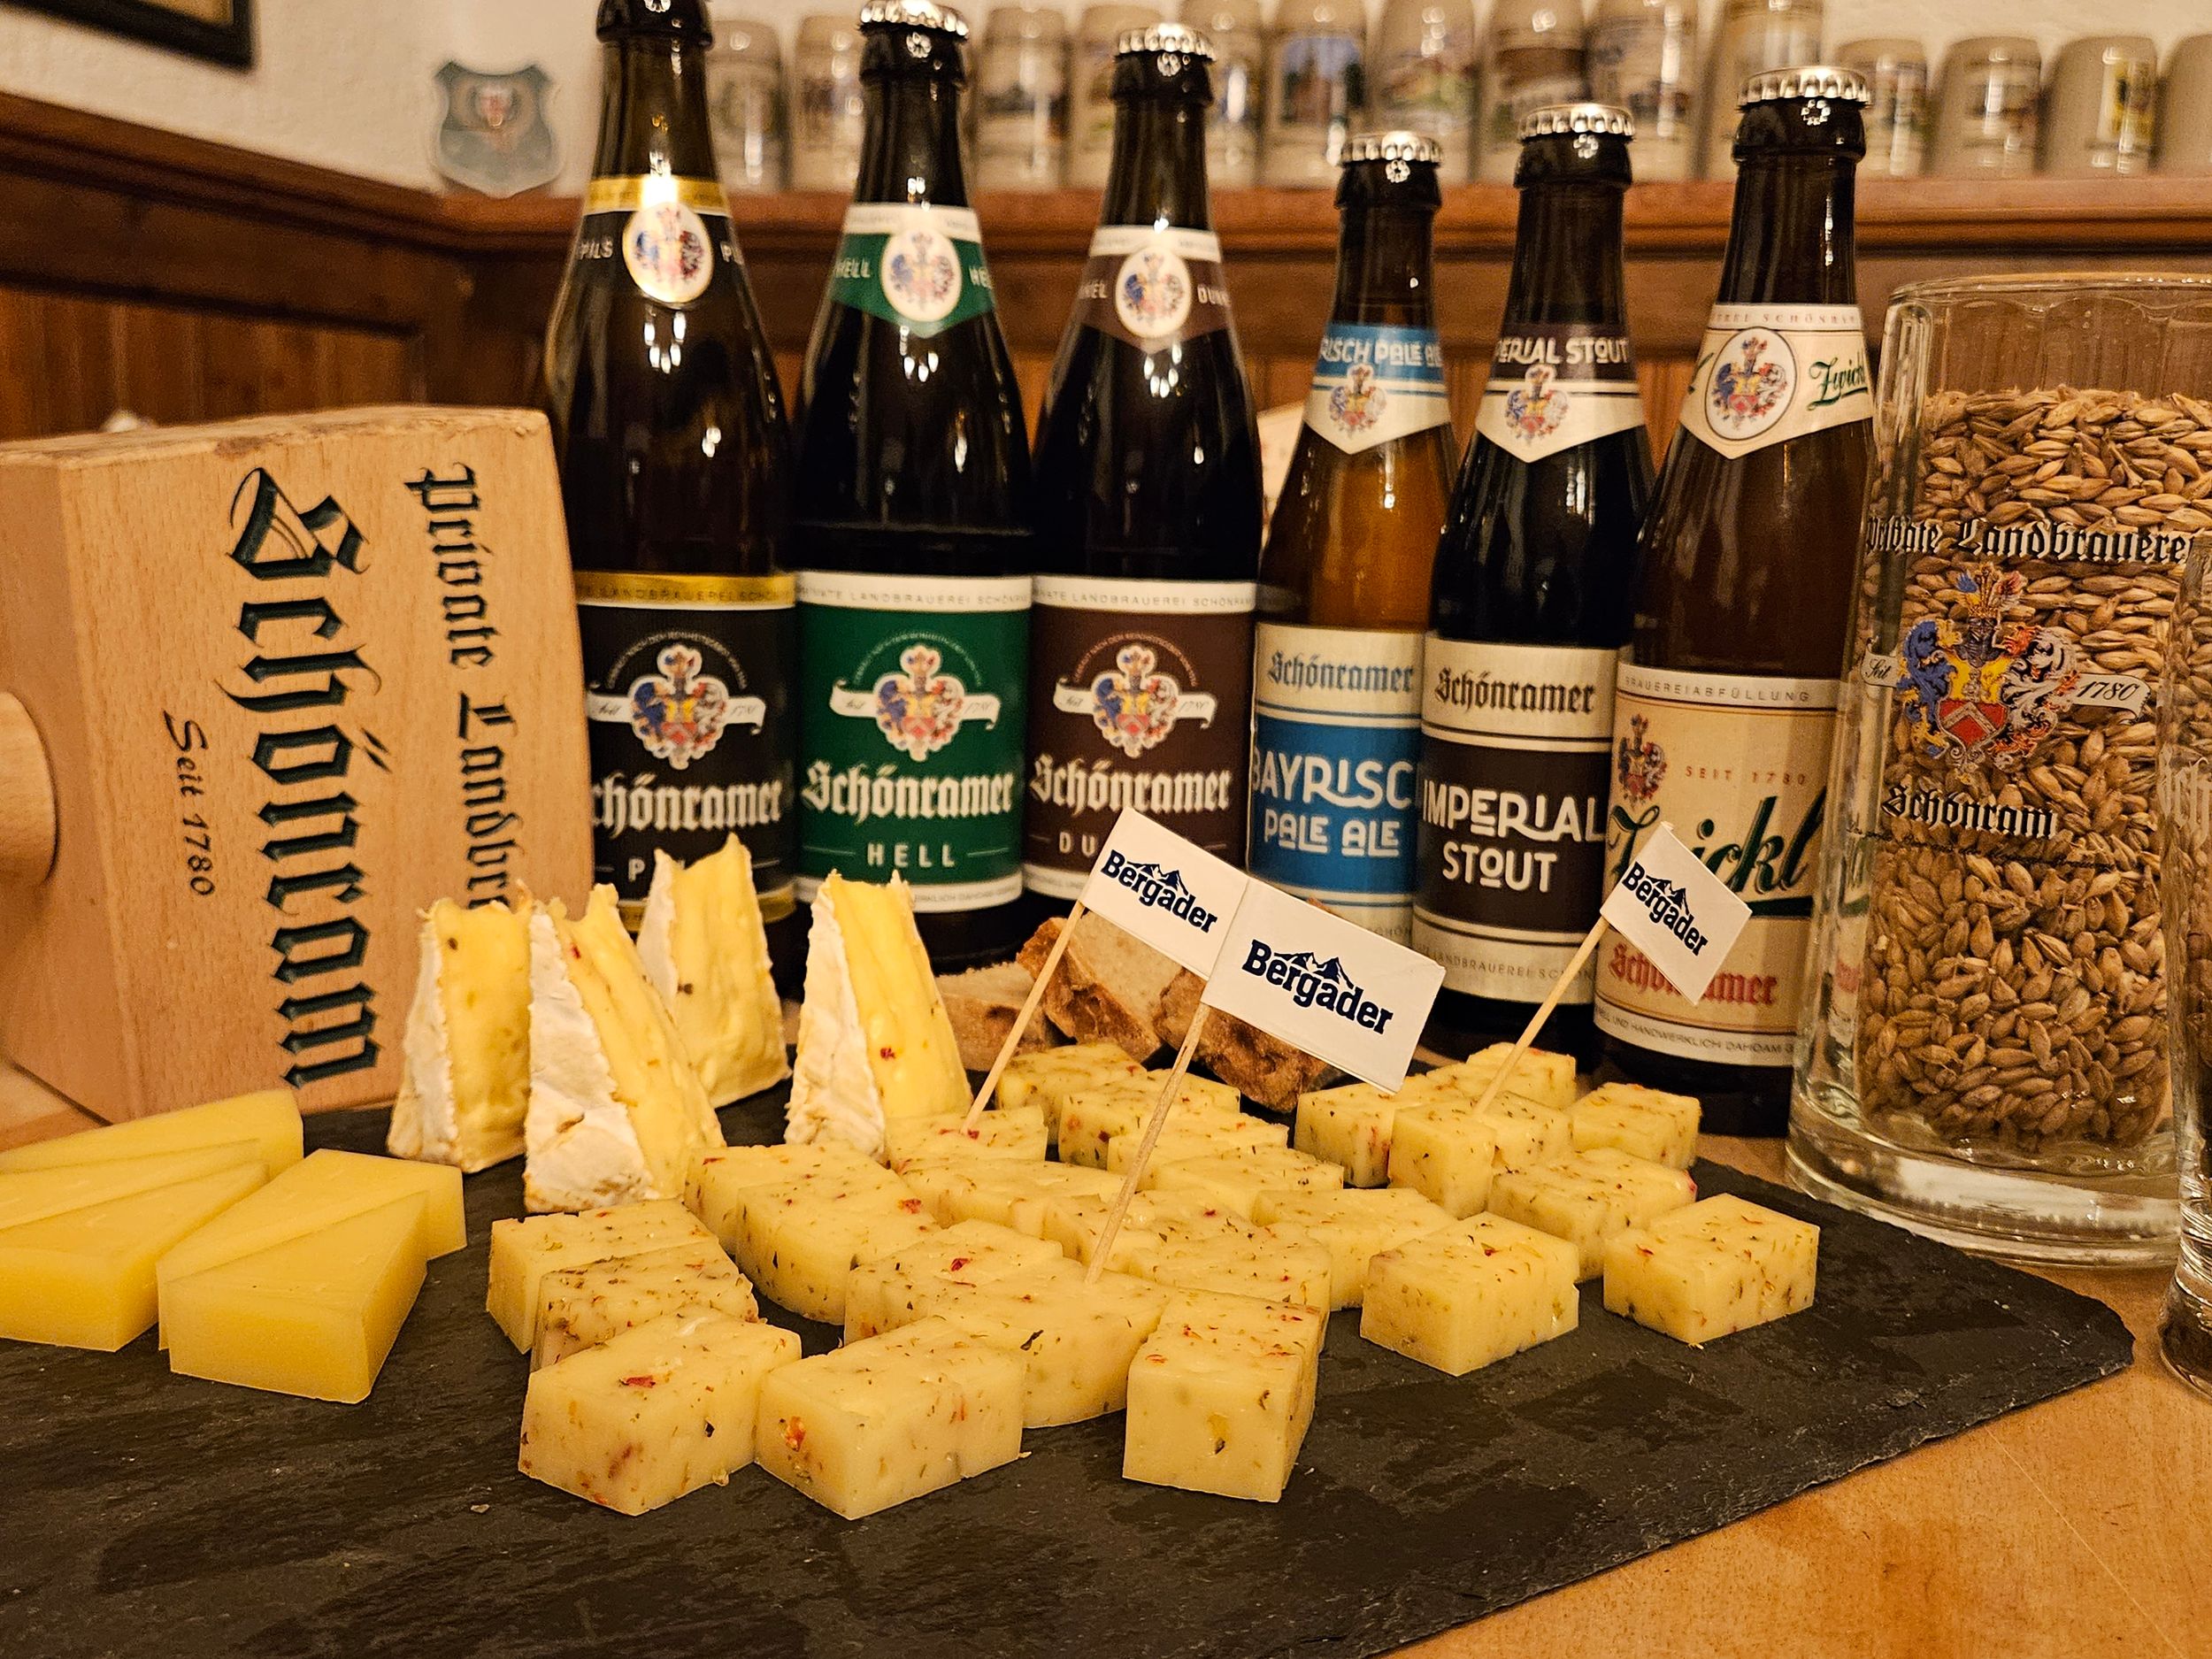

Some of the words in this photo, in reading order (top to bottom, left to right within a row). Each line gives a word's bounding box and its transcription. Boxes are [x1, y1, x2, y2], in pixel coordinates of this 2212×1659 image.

[1374, 339, 1423, 366] PALE
[1565, 336, 1629, 365] STOUT
[1267, 649, 1415, 694] Schönramer
[1434, 666, 1595, 714] Schönramer
[2078, 680, 2140, 702] 1780
[163, 709, 209, 798] Seit
[213, 467, 392, 1091] Schönram
[1029, 753, 1233, 818] Schönramer
[1251, 745, 1414, 810] BAYRISC
[1686, 765, 1732, 780] SEIT
[593, 772, 782, 840] hönramer
[801, 759, 1015, 826] Schönramer
[1423, 779, 1607, 842] IMPERIAL
[182, 813, 215, 896] 1780
[867, 841, 956, 868] HELL
[1263, 809, 1329, 854] PALE
[1341, 819, 1401, 857] ALE
[1606, 784, 1827, 895] Zickl
[1101, 849, 1217, 933] Bergader
[1442, 841, 1558, 894] STOUT
[1622, 861, 1709, 956] Bergader
[1242, 940, 1394, 1034] Bergader
